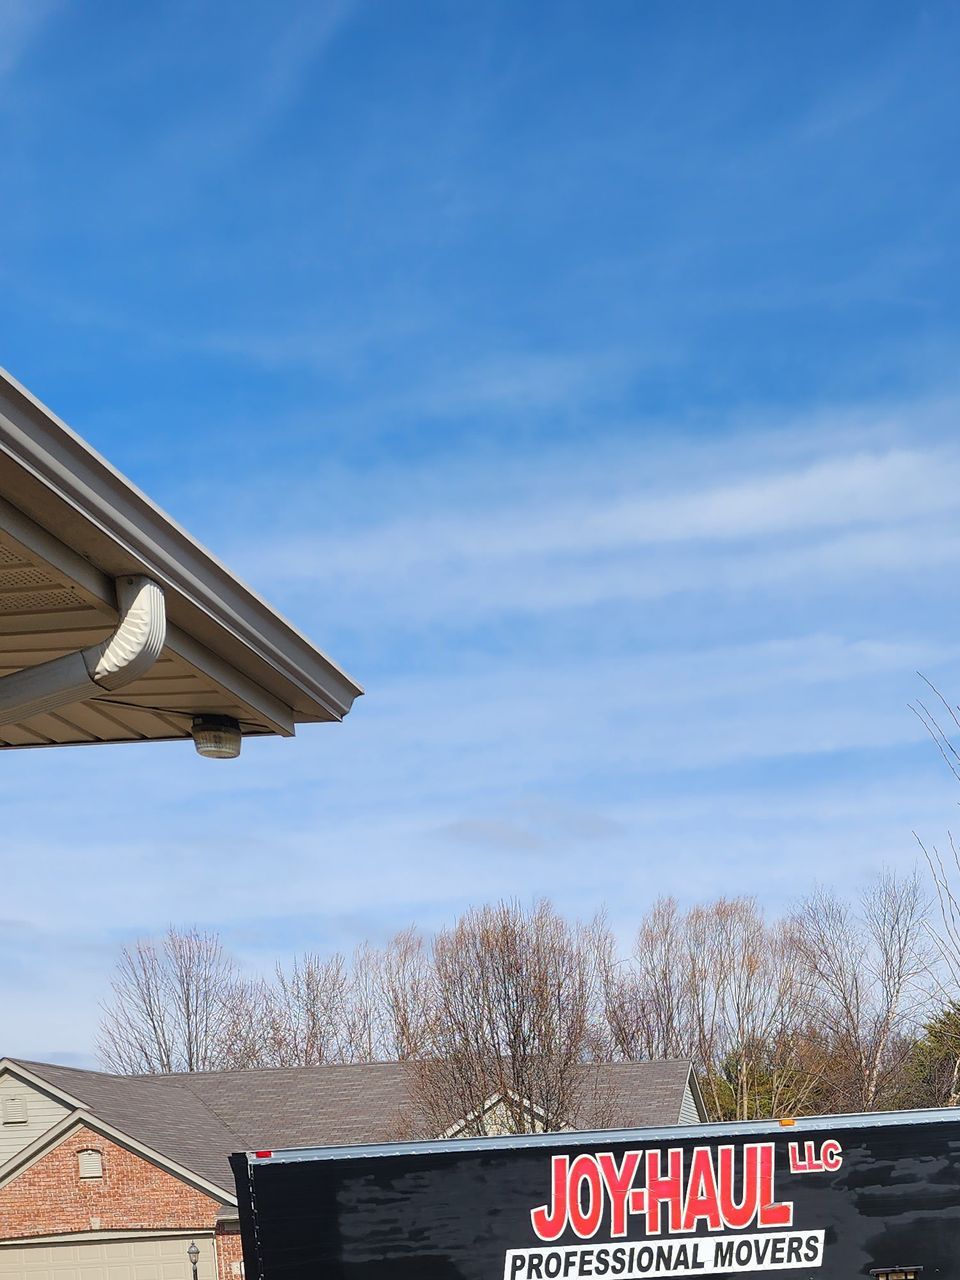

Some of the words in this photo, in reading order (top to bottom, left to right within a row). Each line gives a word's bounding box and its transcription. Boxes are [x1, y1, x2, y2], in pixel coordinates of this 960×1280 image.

[530, 1142, 793, 1241] JOY-HAUL
[788, 1139, 843, 1174] LLC
[713, 1235, 820, 1269] MOVERS
